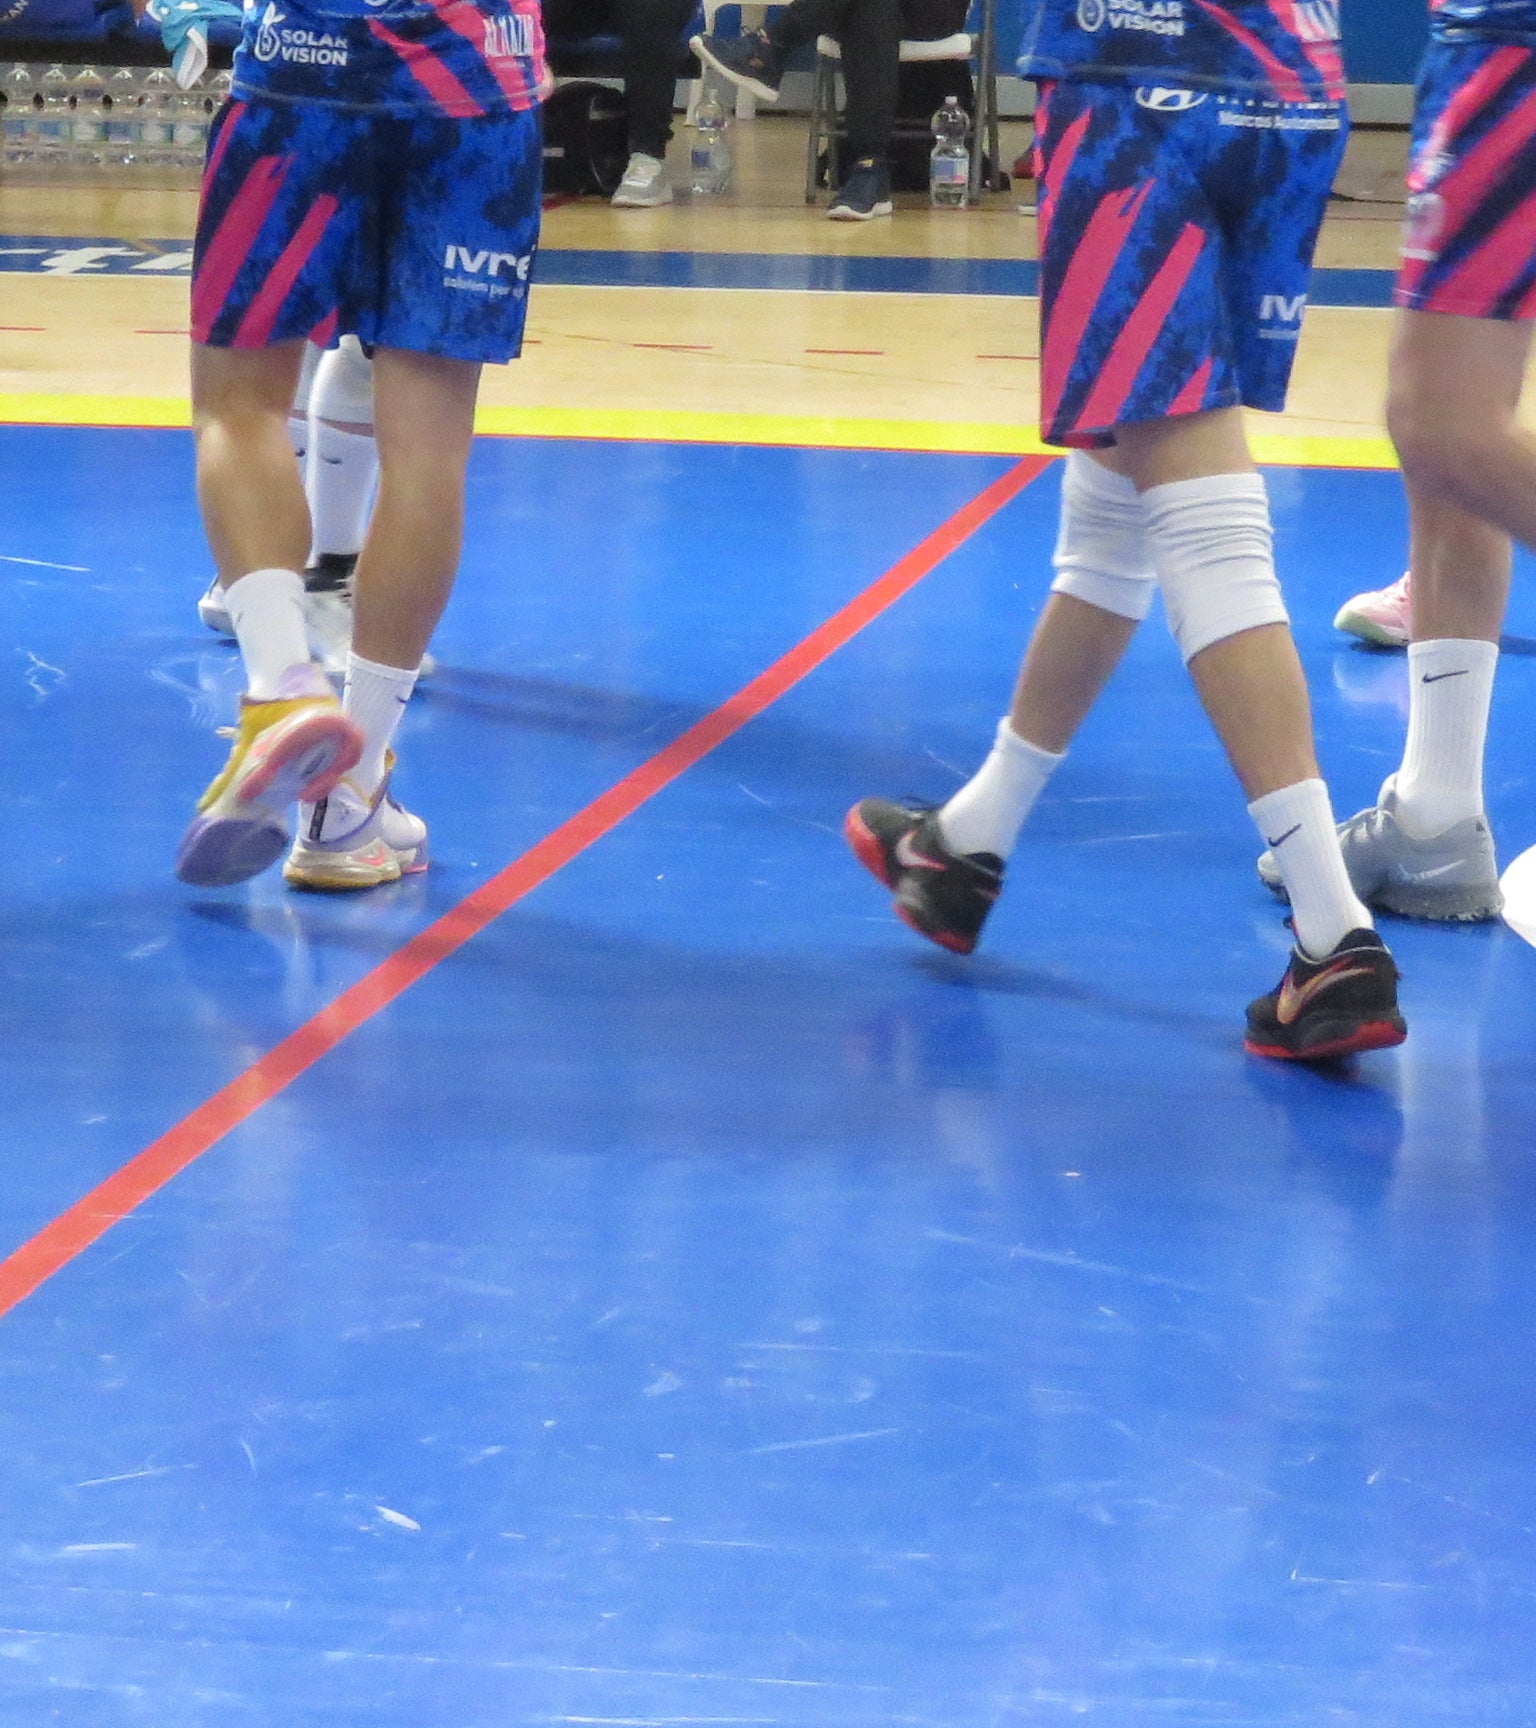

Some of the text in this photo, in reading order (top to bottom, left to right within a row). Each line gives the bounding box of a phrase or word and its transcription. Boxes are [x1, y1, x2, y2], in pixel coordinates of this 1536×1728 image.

[1109, 11, 1185, 37] VISION
[281, 28, 348, 50] SOLAR
[282, 46, 349, 67] VISION
